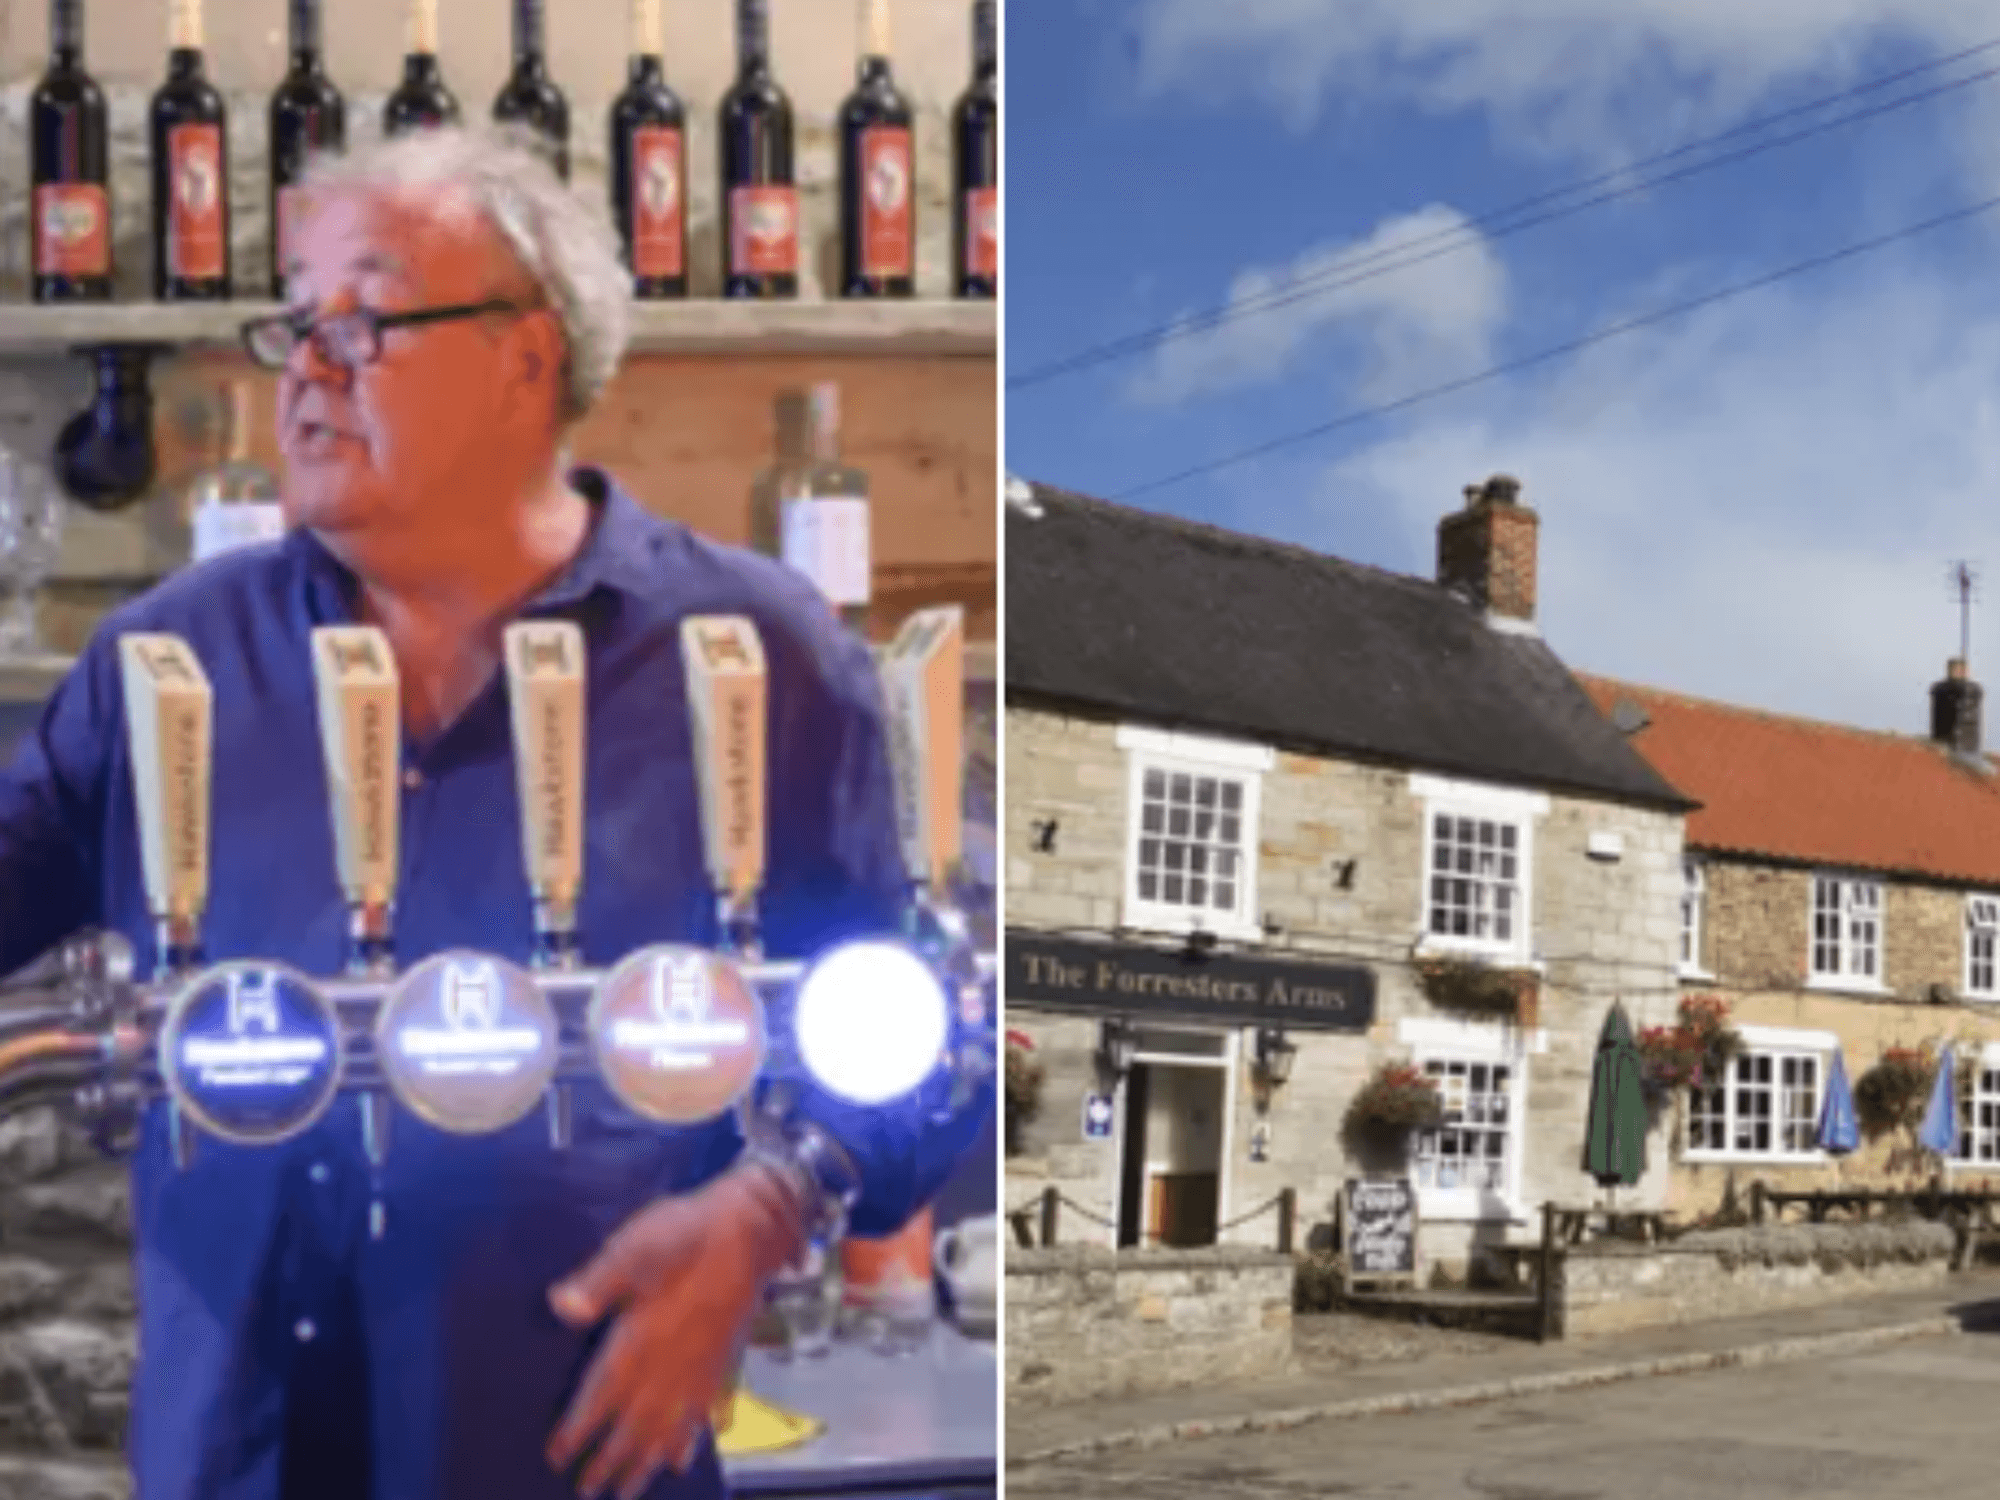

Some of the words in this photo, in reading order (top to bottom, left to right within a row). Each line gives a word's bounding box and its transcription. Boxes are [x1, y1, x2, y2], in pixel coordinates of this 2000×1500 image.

[1022, 954, 1086, 989] The
[1095, 962, 1258, 1001] Forresters
[1264, 977, 1346, 1010] Arms
